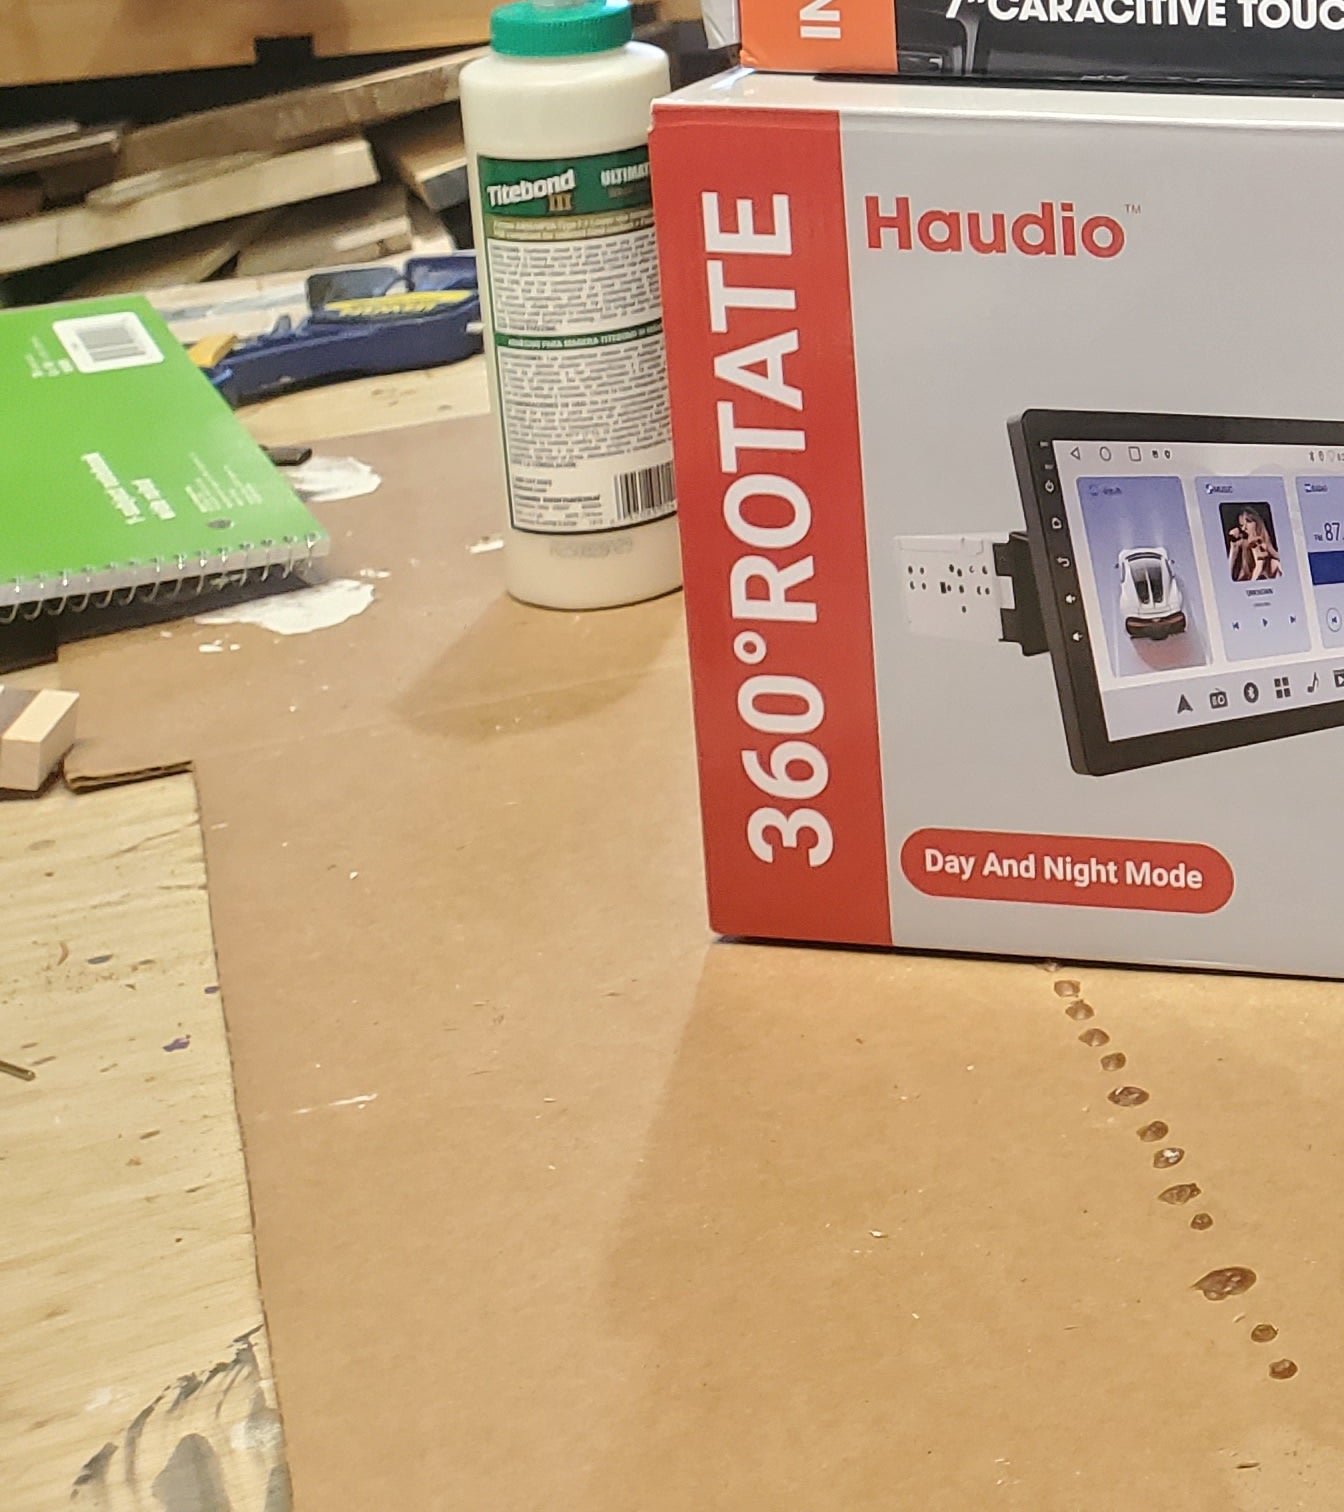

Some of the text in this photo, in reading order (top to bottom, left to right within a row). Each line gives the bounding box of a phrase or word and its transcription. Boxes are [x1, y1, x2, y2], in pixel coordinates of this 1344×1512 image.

[486, 168, 576, 208] Titebond
[864, 195, 1126, 260] Haudio
[924, 849, 1204, 889] Day And Night Mode
